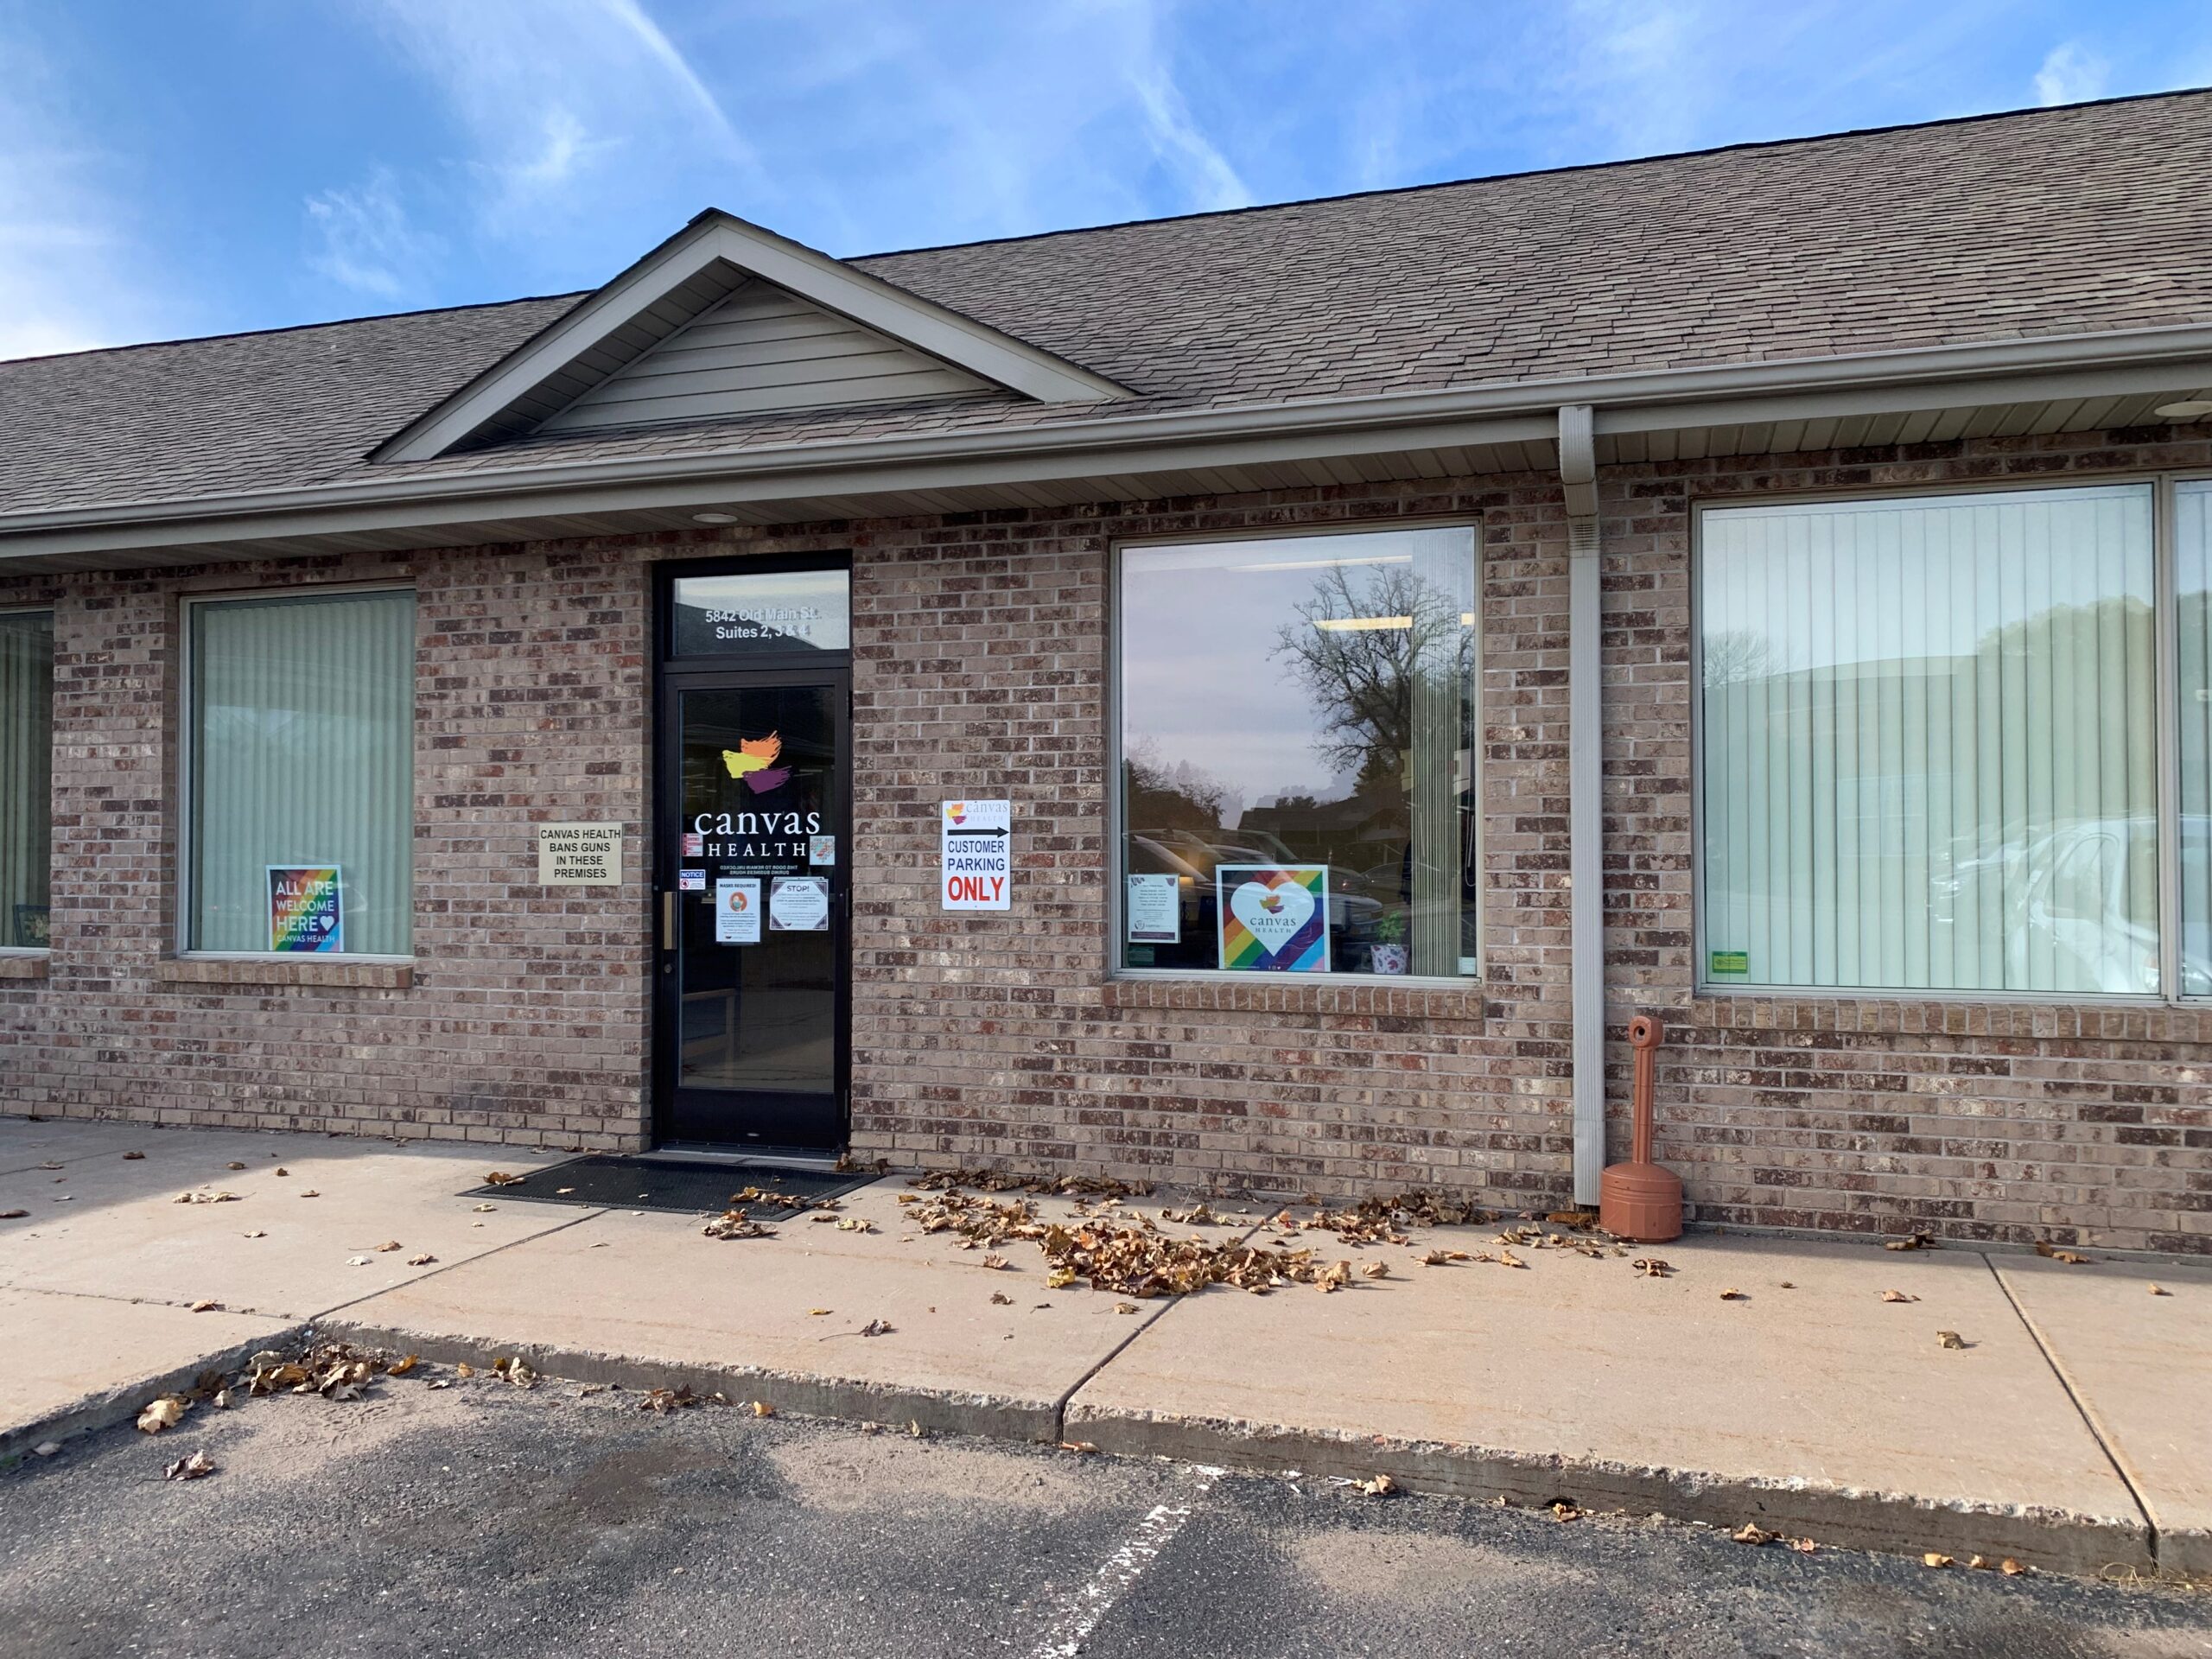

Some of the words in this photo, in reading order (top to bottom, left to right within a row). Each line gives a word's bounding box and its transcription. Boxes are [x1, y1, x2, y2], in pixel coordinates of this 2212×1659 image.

[705, 610, 736, 622] 5842
[739, 608, 761, 621] Old
[766, 607, 797, 620] Main
[715, 626, 758, 639] Suites
[760, 625, 772, 639] 2,
[774, 624, 783, 638] 3
[785, 624, 796, 637] &
[798, 624, 808, 635] 4
[966, 803, 1008, 813] canvas
[694, 811, 821, 836] canvas
[540, 830, 580, 840] CANVAS
[582, 829, 621, 839] HEALTH
[550, 842, 578, 853] BANS
[581, 842, 611, 853] GUNS
[708, 842, 806, 857] HEALTH
[948, 840, 1005, 853] CUSTOMER
[556, 855, 566, 865] IN
[569, 855, 603, 865] THESE
[948, 858, 1005, 871] PARKING
[554, 868, 607, 879] PREMISES
[276, 880, 302, 896] ALL
[304, 880, 334, 896] ARE
[948, 875, 1005, 901] ONLY
[276, 900, 335, 912] WELCOME
[276, 916, 319, 932] HERE
[1249, 917, 1296, 926] canvas
